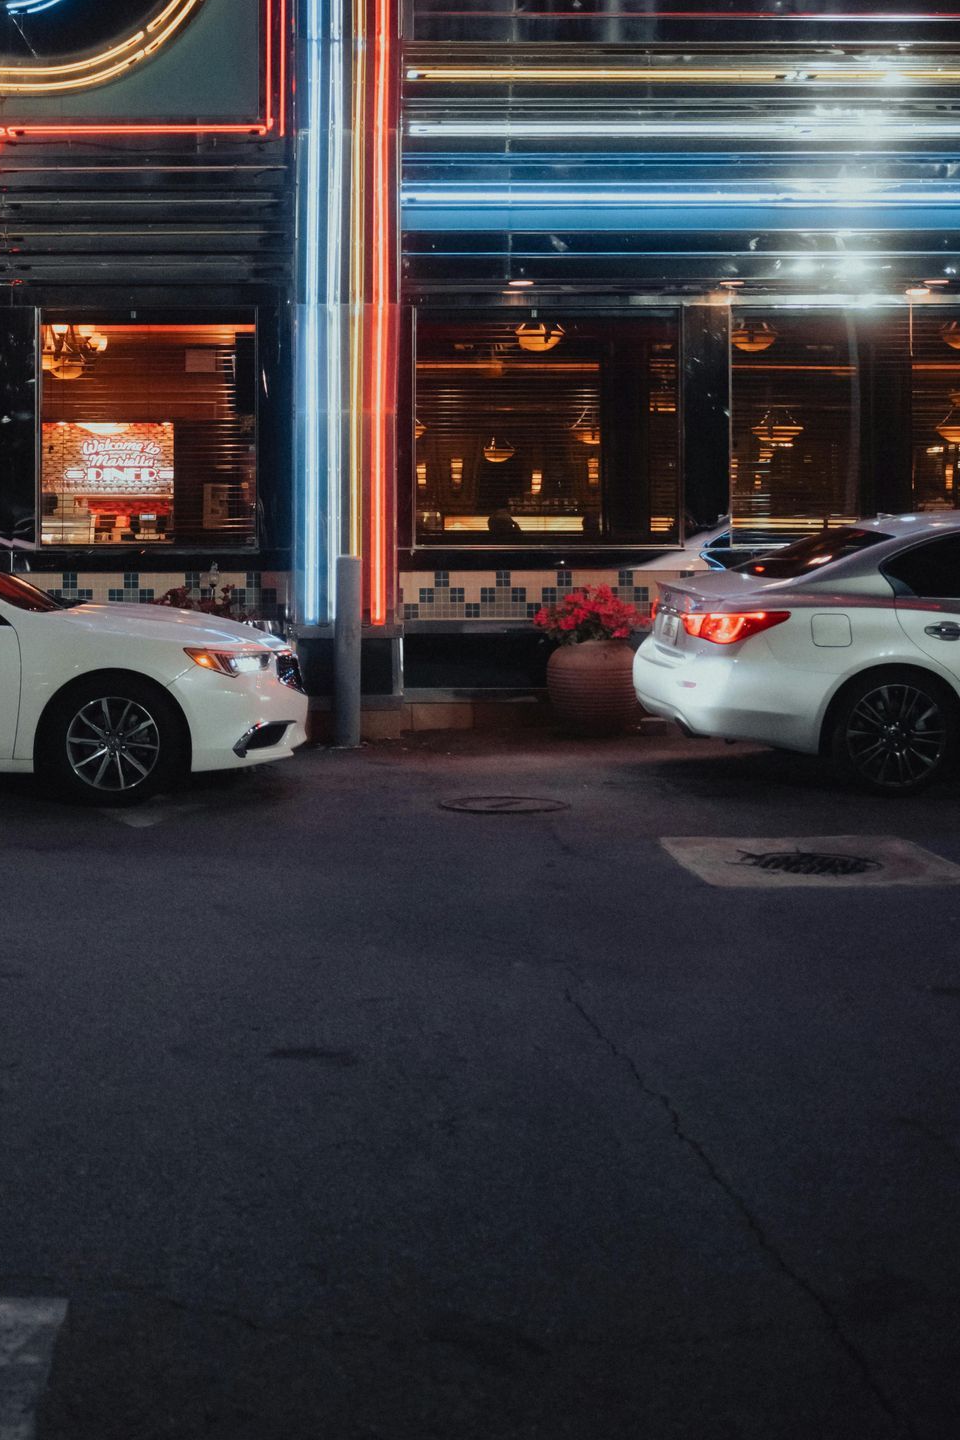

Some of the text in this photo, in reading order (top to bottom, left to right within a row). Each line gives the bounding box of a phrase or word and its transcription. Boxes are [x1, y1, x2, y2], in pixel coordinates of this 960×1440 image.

[82, 438, 143, 456] Welcome
[88, 453, 155, 467] Marietta
[87, 467, 157, 481] DINER
